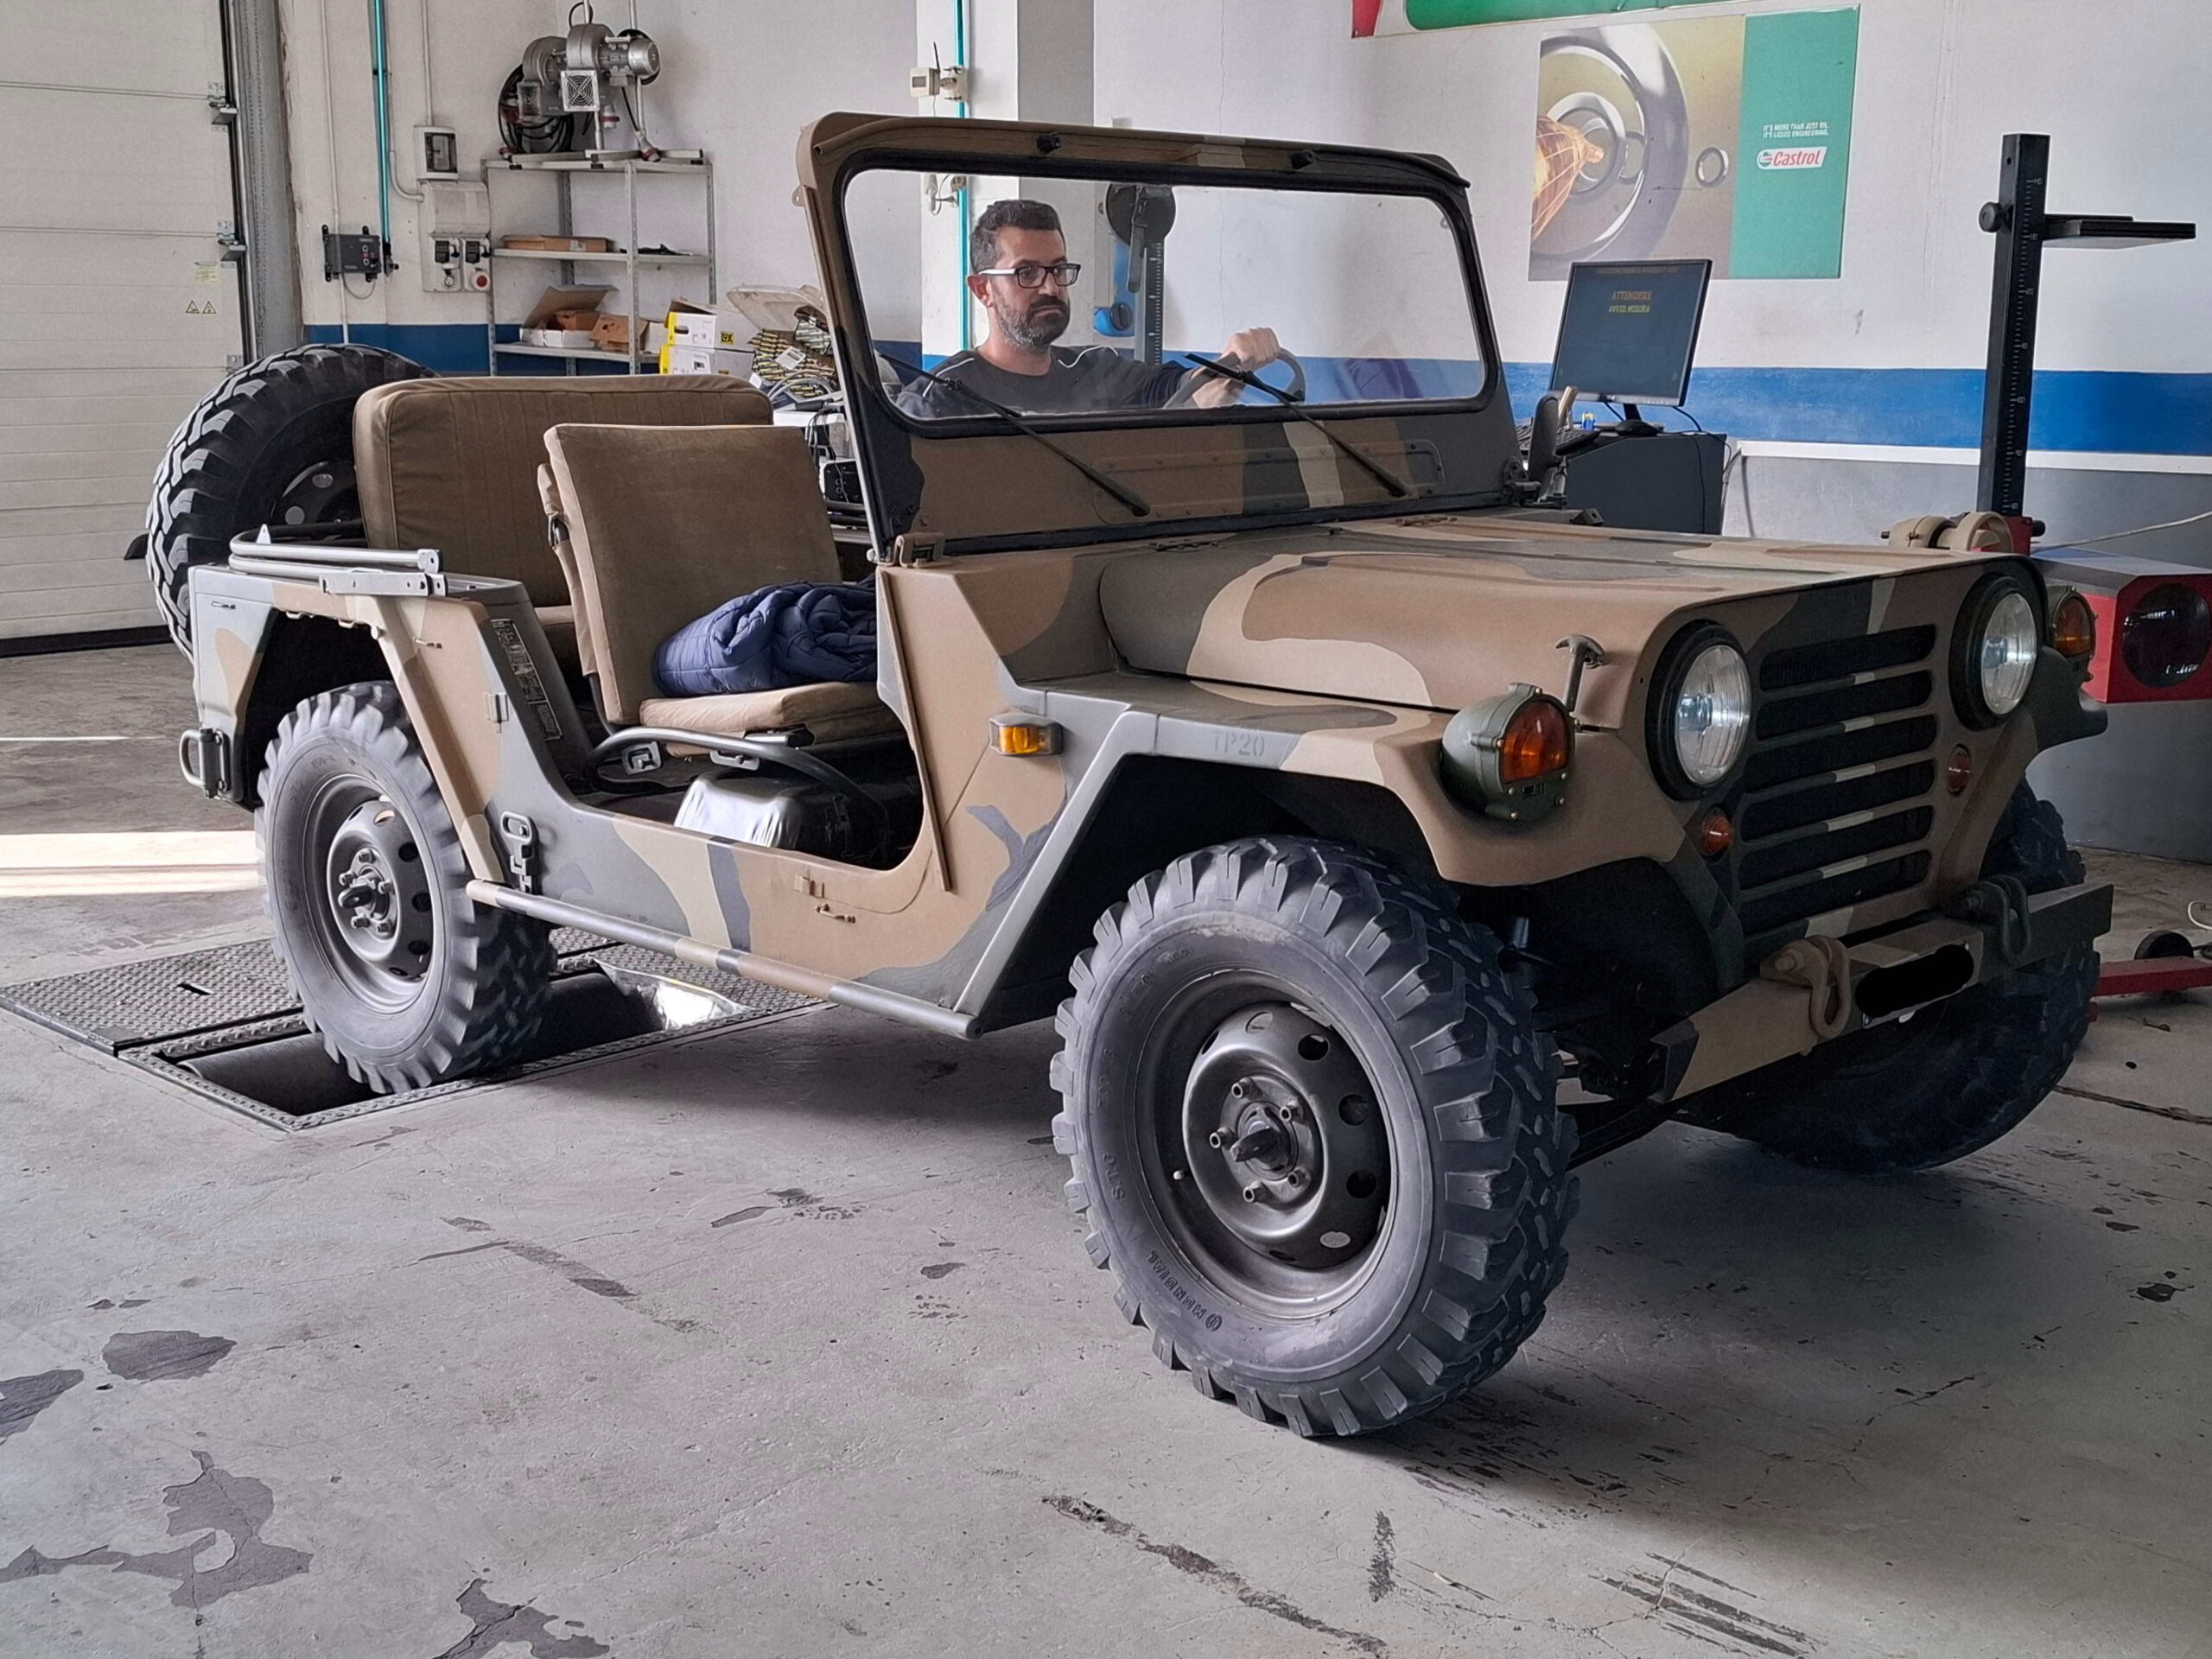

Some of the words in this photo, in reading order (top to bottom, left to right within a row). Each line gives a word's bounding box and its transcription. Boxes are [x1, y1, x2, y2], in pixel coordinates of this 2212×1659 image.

[1773, 149, 1821, 167] Castrol
[1212, 730, 1265, 757] TP20
[1147, 1249, 1207, 1320] MUNDIAL
